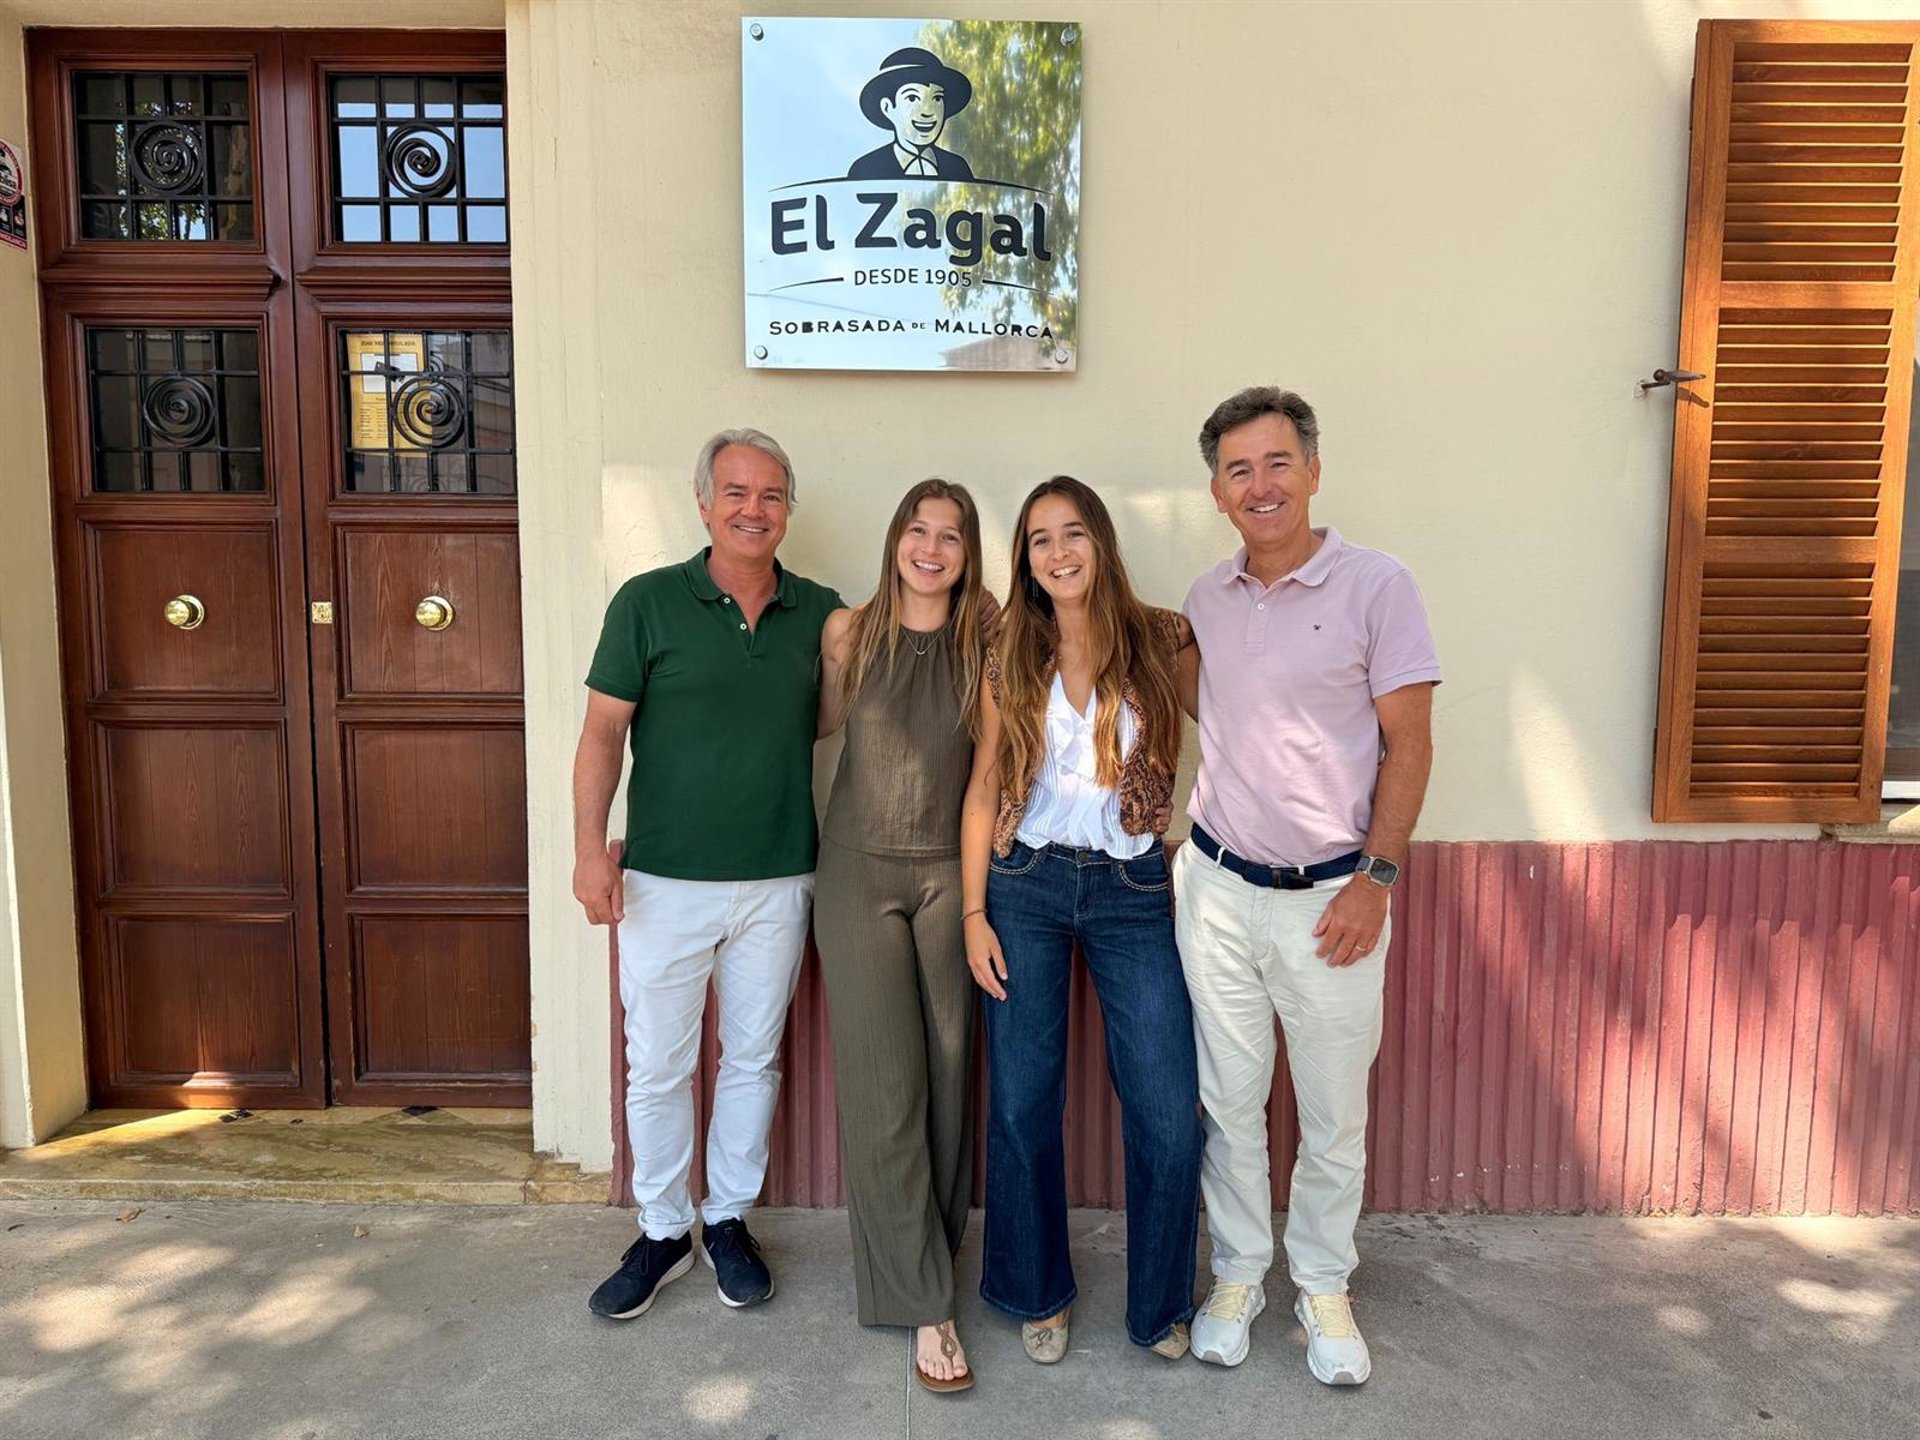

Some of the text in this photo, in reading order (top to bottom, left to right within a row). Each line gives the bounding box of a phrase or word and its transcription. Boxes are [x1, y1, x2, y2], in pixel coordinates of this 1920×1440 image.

[771, 192, 1052, 267] El Zagal
[855, 268, 973, 288] DESDE 1905
[769, 319, 906, 336] SOBRASADA
[935, 318, 1053, 340] MALLORCA
